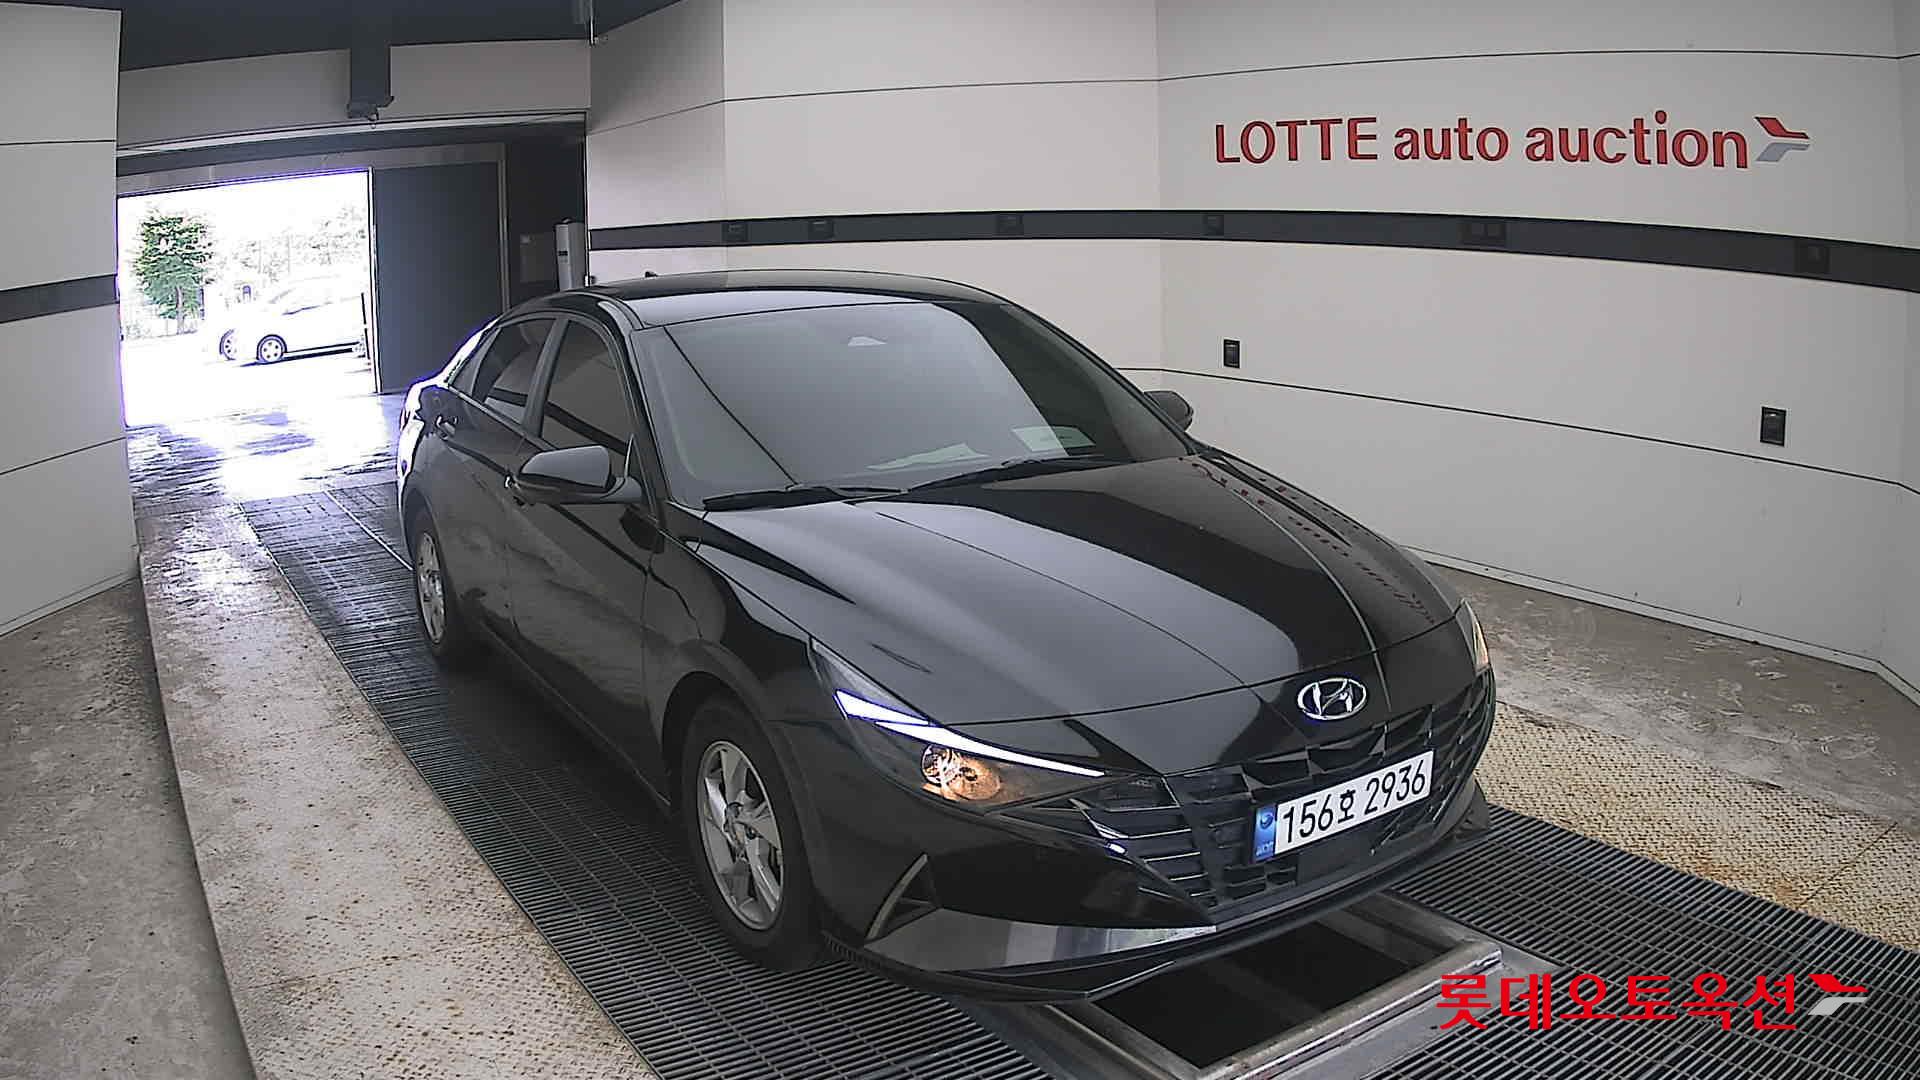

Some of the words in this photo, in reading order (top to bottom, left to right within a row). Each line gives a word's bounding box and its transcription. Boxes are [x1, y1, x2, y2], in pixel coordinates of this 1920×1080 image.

[1215, 117, 1378, 163] LOTTE
[1393, 118, 1510, 161] auto
[1525, 111, 1748, 168] auction
[1283, 789, 1355, 843] 156호
[1364, 760, 1426, 815] 2936
